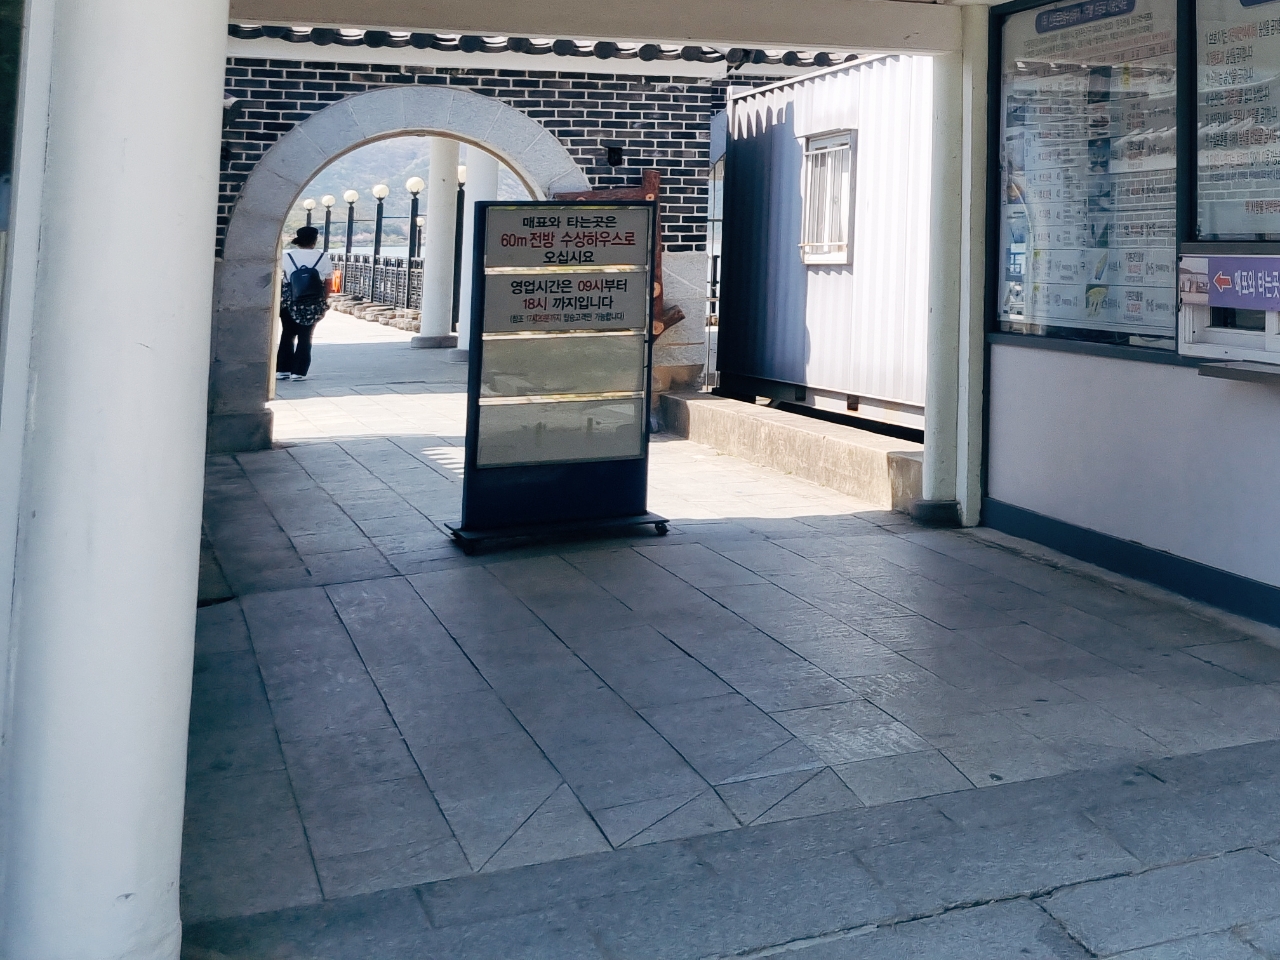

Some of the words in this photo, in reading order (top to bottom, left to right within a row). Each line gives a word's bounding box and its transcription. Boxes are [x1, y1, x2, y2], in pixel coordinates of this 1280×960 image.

[522, 215, 562, 229] 매표와
[567, 215, 618, 229] 타는곳은
[560, 231, 636, 249] 수상하우스로
[543, 250, 595, 264] 오십시요
[510, 279, 573, 295] 영업시간은
[577, 278, 628, 293] 09시부터
[522, 296, 547, 311] 18시
[552, 295, 614, 311] 까지입니다
